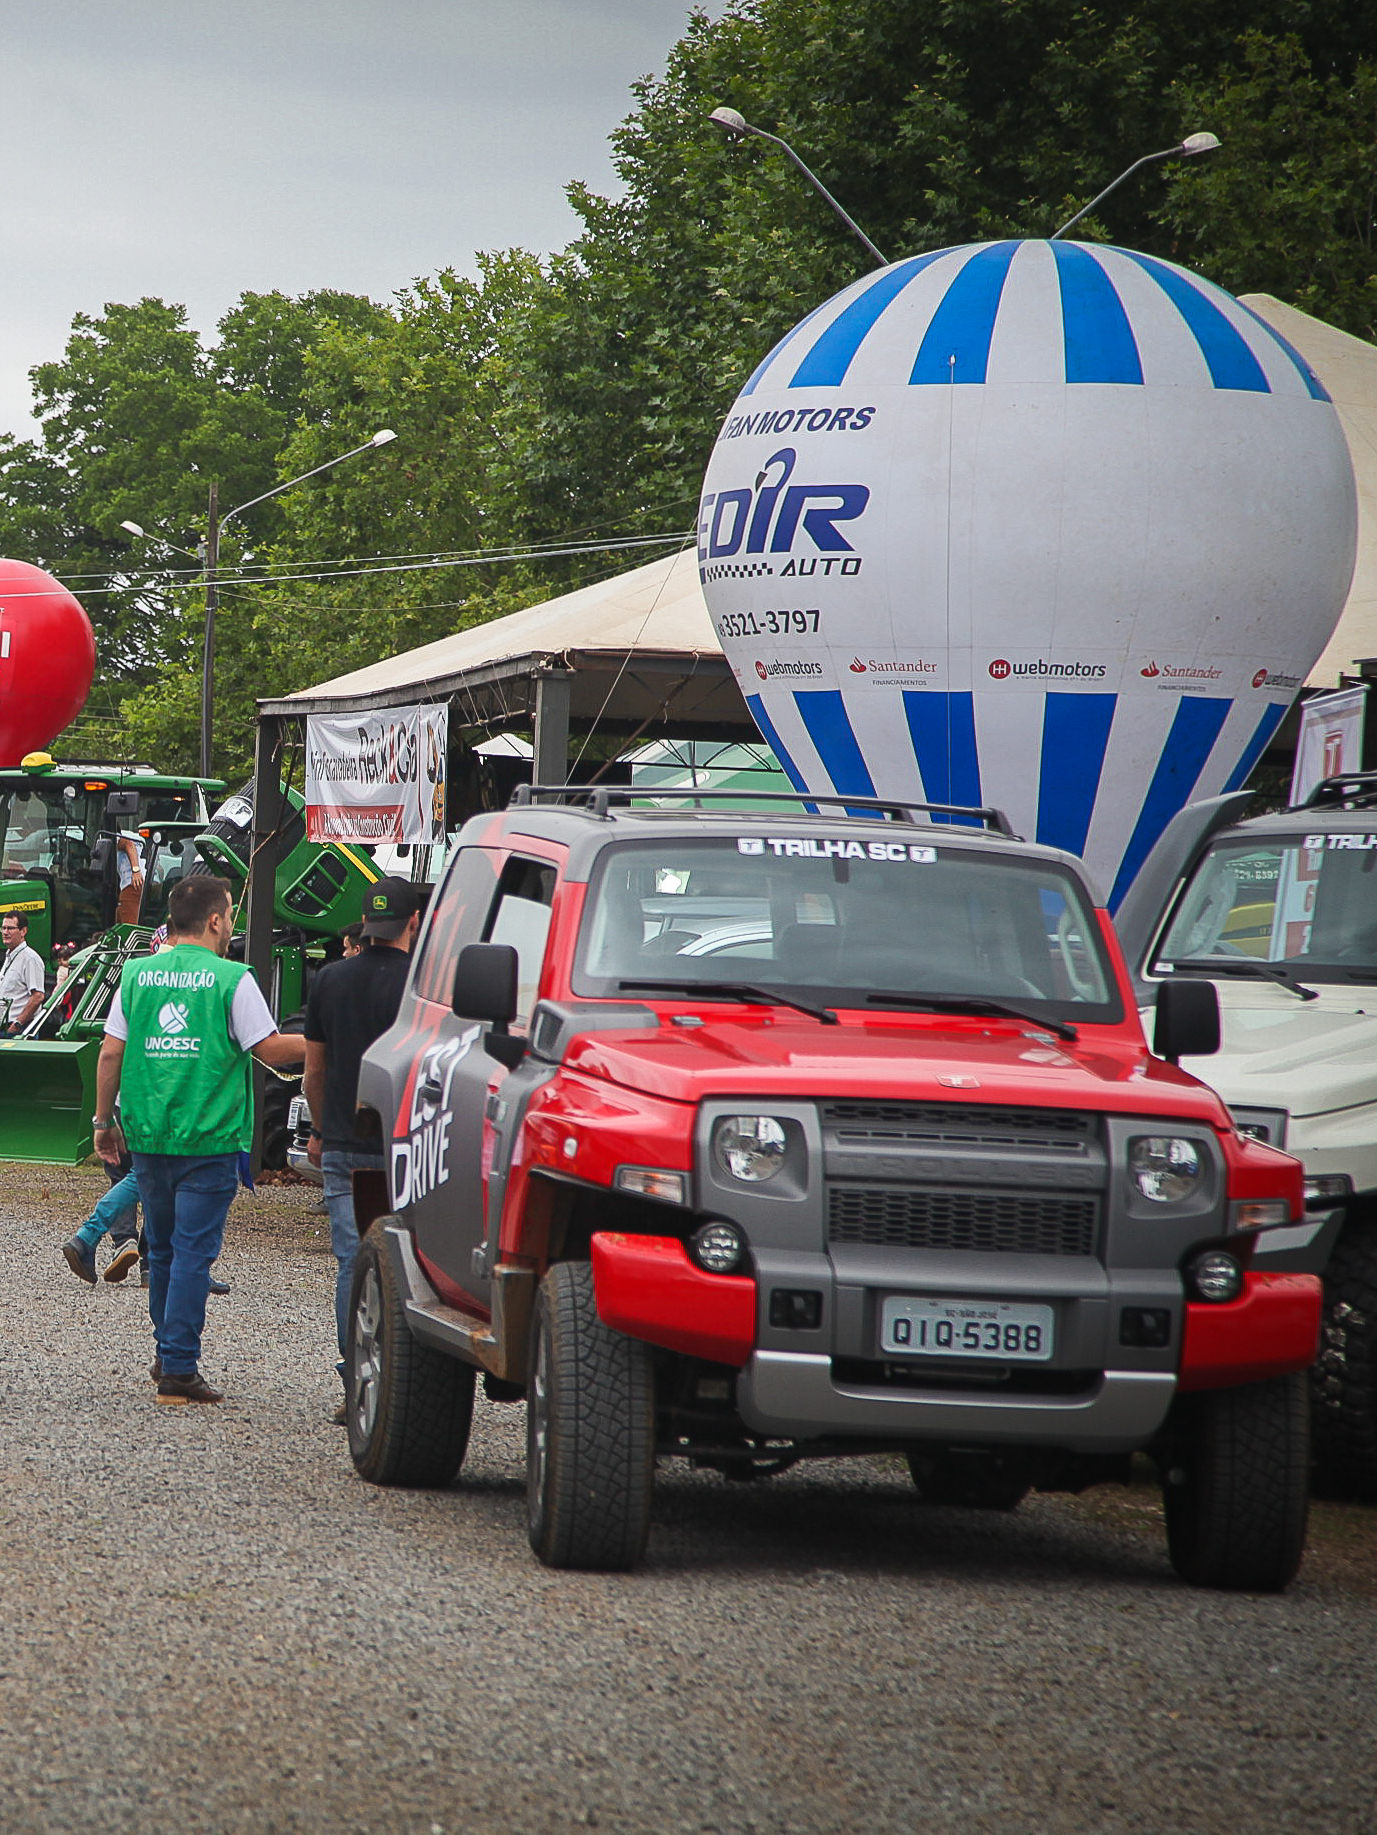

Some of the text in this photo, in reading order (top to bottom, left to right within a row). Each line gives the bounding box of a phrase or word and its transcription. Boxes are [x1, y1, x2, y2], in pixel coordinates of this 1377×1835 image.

[755, 407, 876, 435] MOTORS
[780, 558, 862, 576] AUTO
[722, 609, 820, 638] 3521-3797
[766, 659, 822, 675] webmotors
[868, 659, 937, 673] Santander
[1013, 659, 1107, 677] webmotors
[1162, 664, 1223, 679] Santander
[768, 839, 866, 859] TRILHA
[868, 843, 907, 862] SC
[138, 969, 215, 991] ORGANIZAÇÃO
[145, 1037, 201, 1051] UNOESC
[392, 1111, 453, 1212] DRIVE
